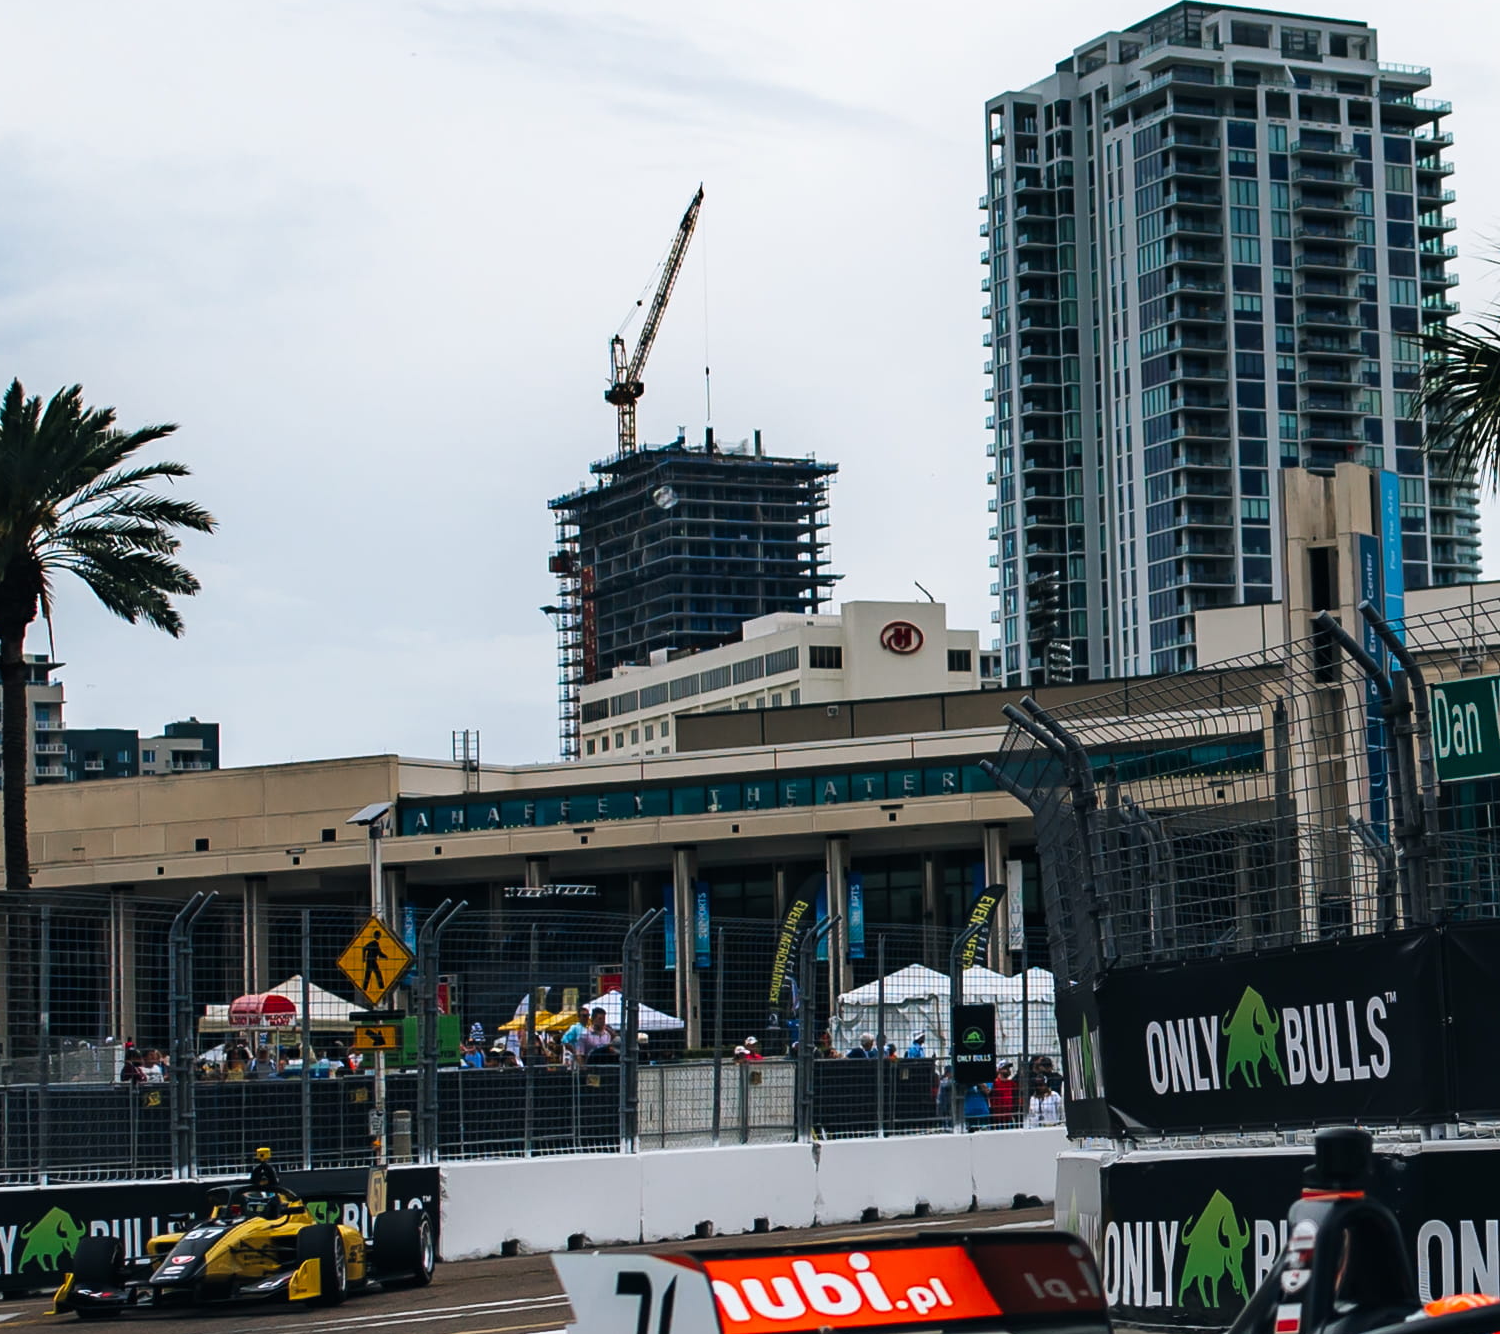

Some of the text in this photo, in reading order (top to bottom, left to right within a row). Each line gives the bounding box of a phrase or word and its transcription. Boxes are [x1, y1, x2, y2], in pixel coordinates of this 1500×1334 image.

[1388, 489, 1397, 515] Arts
[1388, 521, 1397, 543] The
[1366, 552, 1375, 599] Center
[1434, 688, 1483, 759] Dan
[709, 772, 954, 812] THEATER
[1146, 1016, 1221, 1096] ONLY
[185, 1229, 224, 1239] 57
[1105, 1221, 1179, 1308] ONLY
